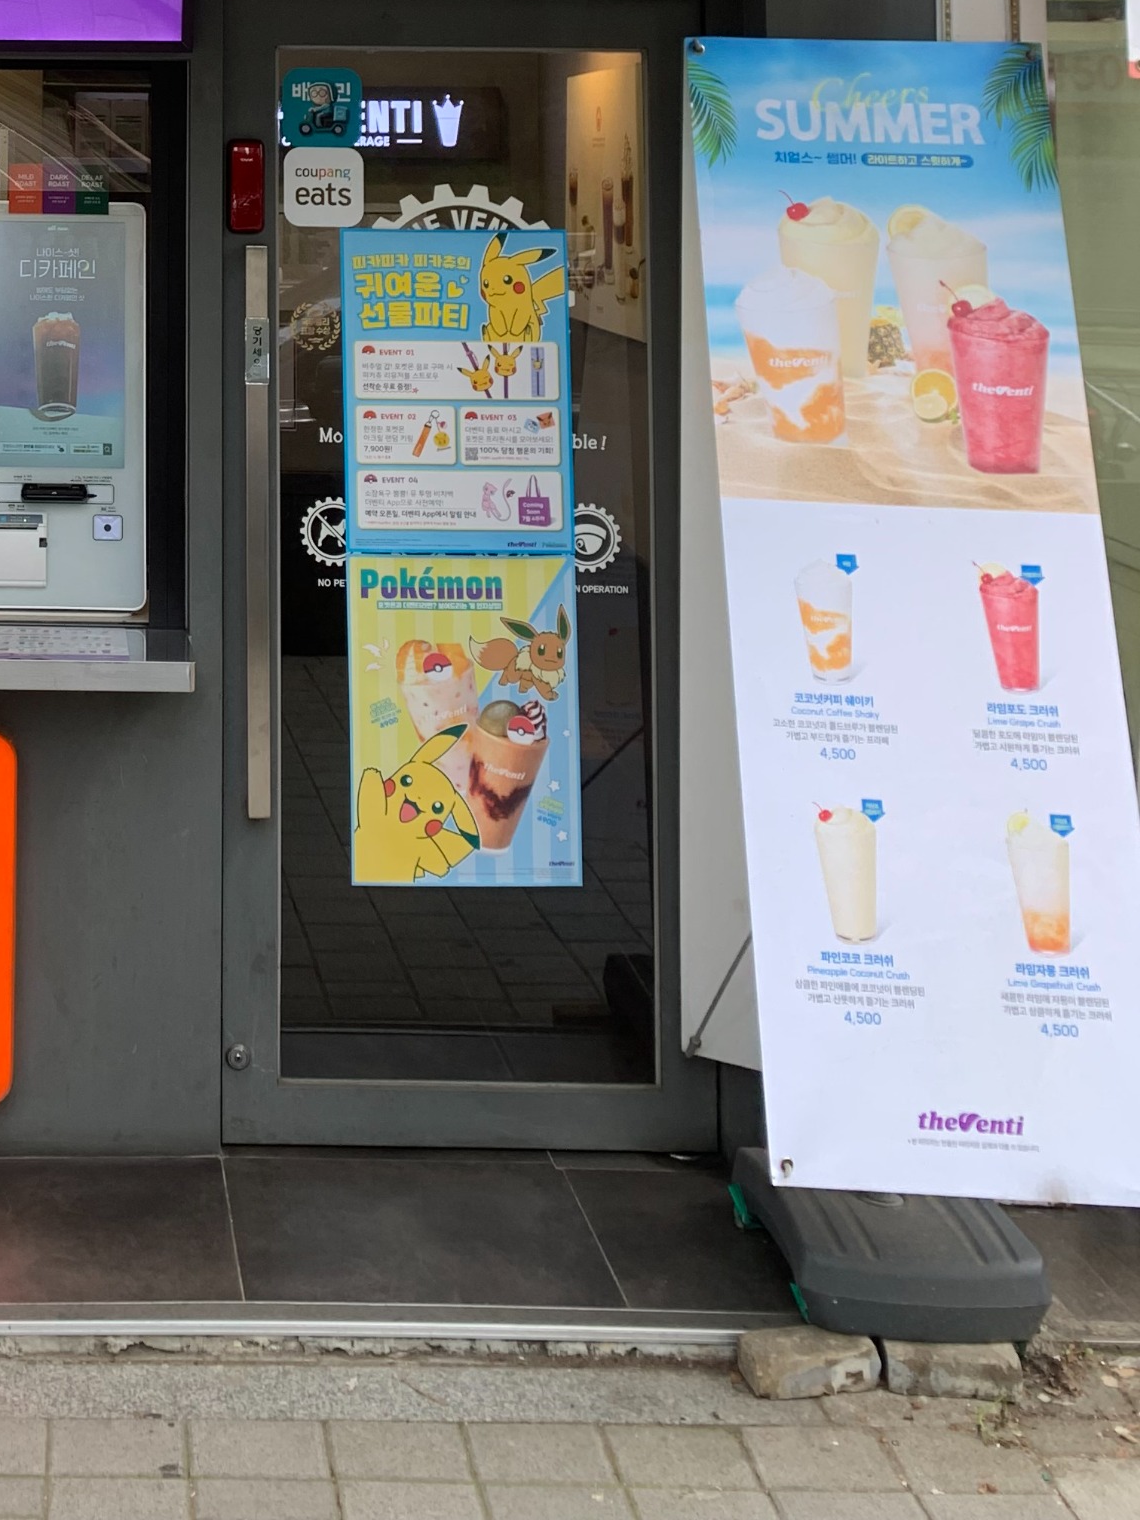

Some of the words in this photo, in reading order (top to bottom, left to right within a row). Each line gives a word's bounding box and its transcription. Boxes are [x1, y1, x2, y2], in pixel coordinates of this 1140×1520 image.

[812, 72, 930, 114] Cheers
[756, 98, 986, 146] SUMMER
[774, 150, 822, 165] 치얼스~
[867, 154, 918, 167] 라이트하고
[294, 165, 352, 181] coupang
[47, 180, 70, 188] ROAST
[294, 182, 353, 207] eats
[19, 259, 96, 279] 디카페인
[351, 253, 410, 269] 피카피카
[412, 253, 472, 270] 피카츄의
[355, 271, 442, 298] 귀여운
[359, 301, 470, 330] 선물파티
[379, 348, 402, 356] EVENT
[405, 348, 415, 356] 01
[972, 381, 1035, 398] theVenti
[319, 427, 344, 444] Mo
[363, 445, 393, 453] 7,900원!
[479, 446, 500, 454] 100%
[381, 476, 405, 484] EVENT
[408, 476, 418, 484] 04
[364, 510, 378, 518] 예약
[401, 510, 422, 518] 더벤티
[423, 510, 450, 519] App에서
[317, 578, 332, 588] NO
[333, 578, 346, 588] PE
[360, 566, 503, 600] Pokémon
[582, 584, 629, 594] OPERATION
[794, 692, 842, 706] 코코넛커피
[791, 706, 824, 717] Coconut
[826, 707, 853, 717] Coffee
[855, 709, 880, 721] Shaky
[986, 702, 1027, 715] 라임포도
[1029, 704, 1059, 718] 크러쉬
[987, 717, 1008, 726] Lime
[1037, 719, 1062, 729] Crush
[820, 747, 857, 761] 4,500
[1010, 758, 1048, 772] 4,500
[820, 950, 862, 964] 파인코코
[864, 953, 895, 968] 크러쉬
[807, 965, 848, 978] Pineapple
[849, 967, 884, 979] Coconut
[885, 970, 911, 980] Crush
[1015, 962, 1057, 977] 라임자몽
[1059, 965, 1090, 980] 크러쉬
[844, 1011, 882, 1025] 4,500
[1040, 1023, 1079, 1038] 4,500
[918, 1110, 1025, 1137] theVenti
